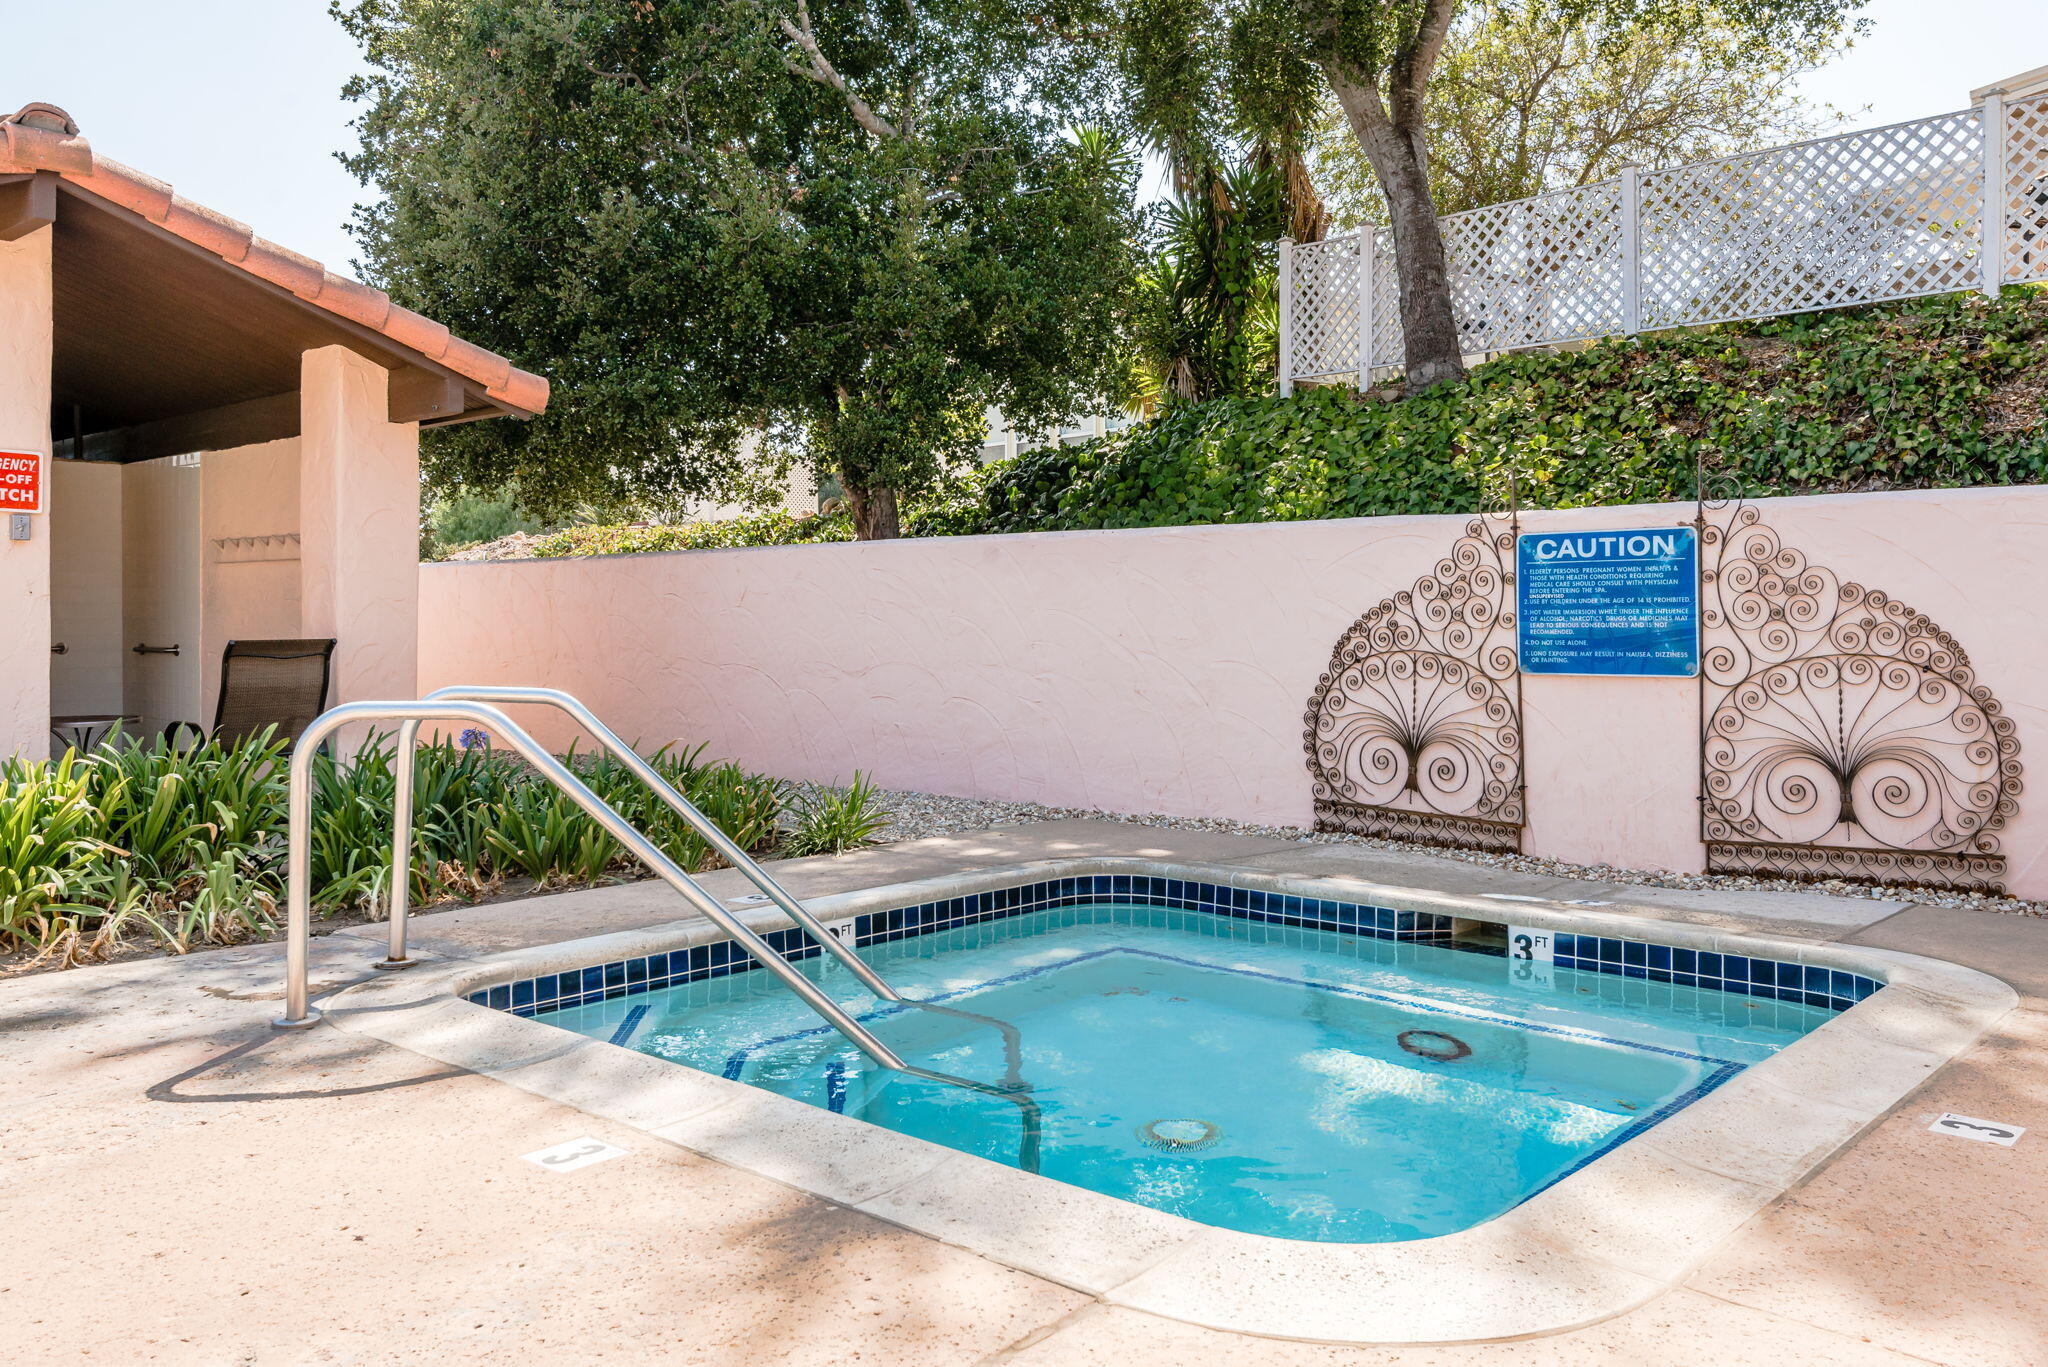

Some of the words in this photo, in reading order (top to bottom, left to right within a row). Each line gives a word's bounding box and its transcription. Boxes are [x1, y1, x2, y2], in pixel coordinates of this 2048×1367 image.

[1537, 535, 1675, 559] CAUTION
[841, 923, 851, 937] FT
[1514, 934, 1533, 960] 3
[1534, 936, 1549, 948] FT
